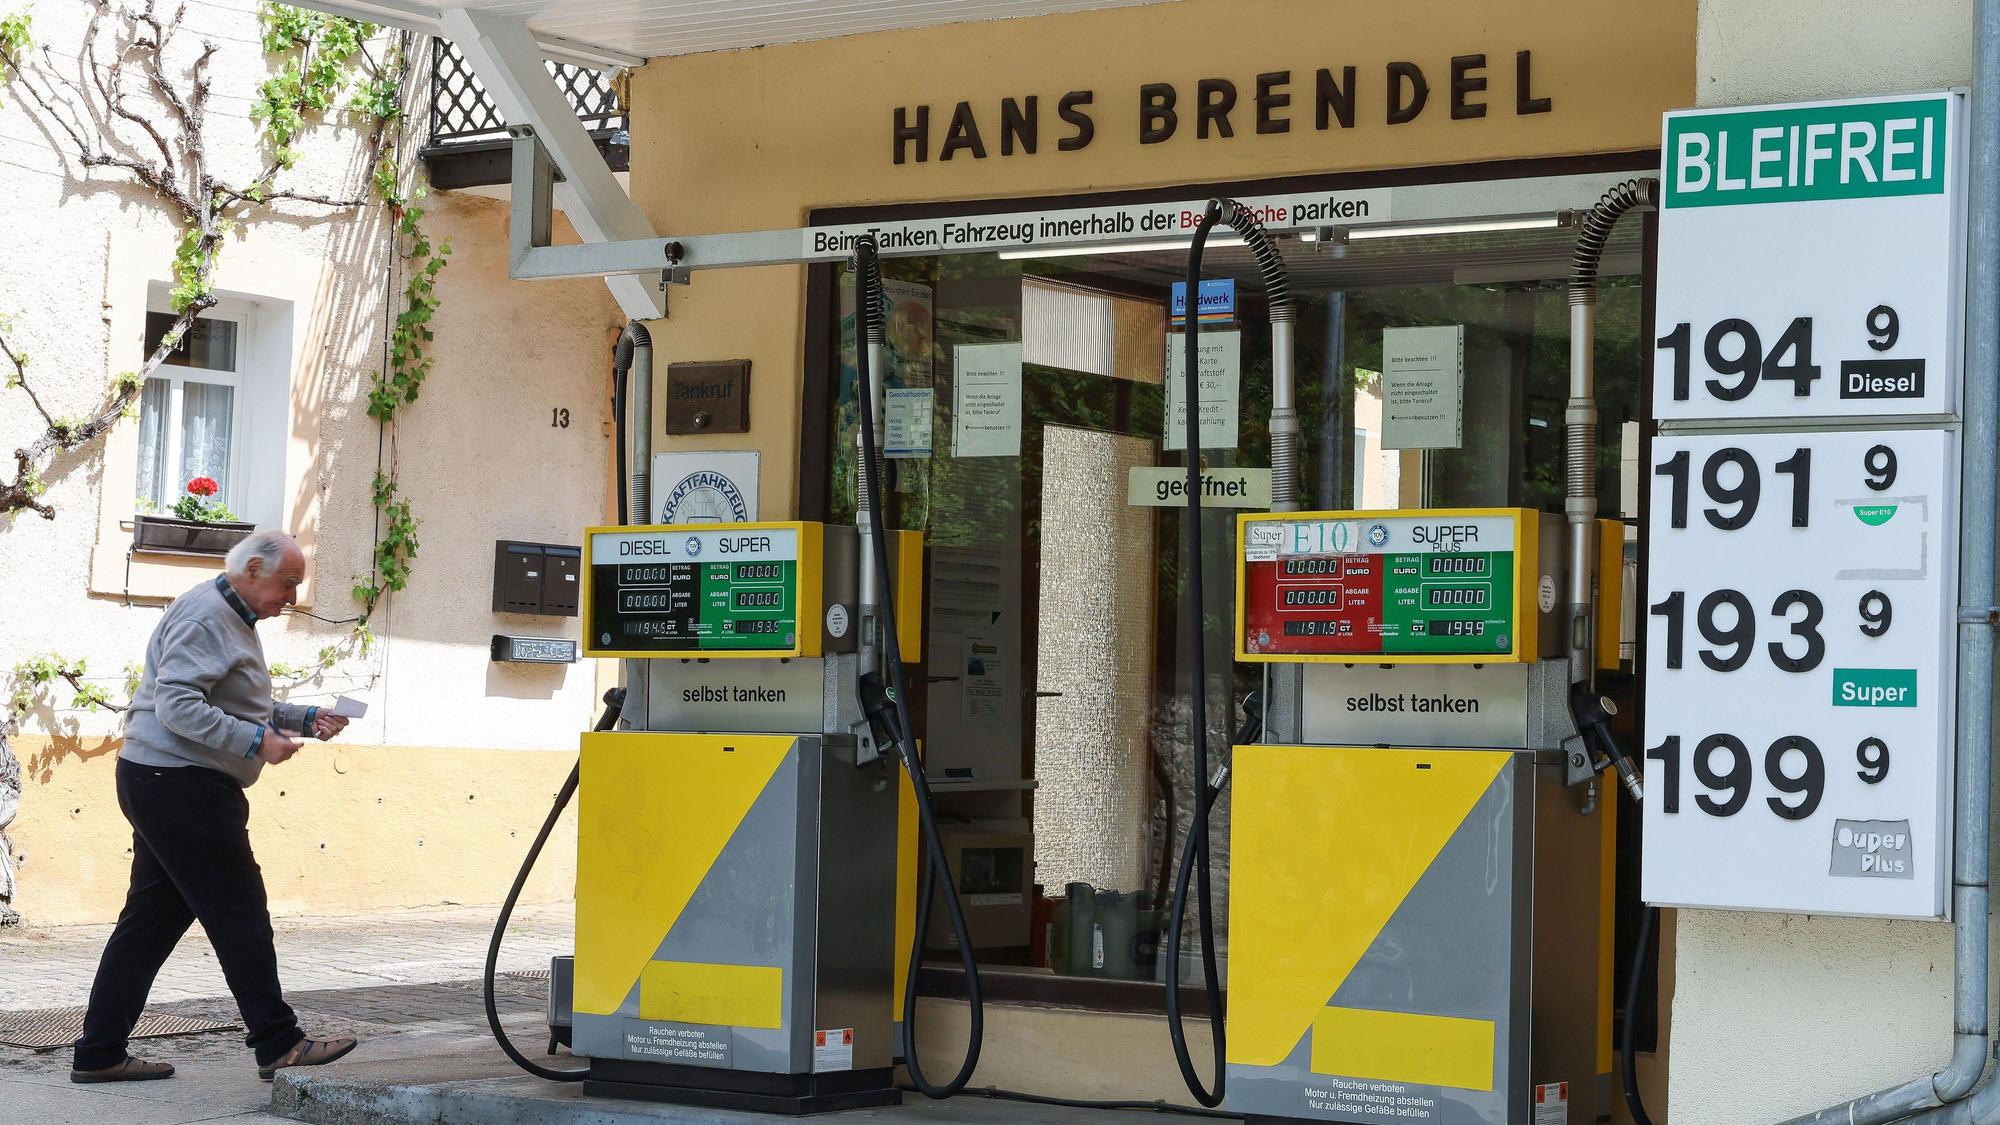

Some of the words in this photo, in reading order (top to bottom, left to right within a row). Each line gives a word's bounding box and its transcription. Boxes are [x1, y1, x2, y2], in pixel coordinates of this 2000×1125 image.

[893, 90, 1095, 165] HANS
[1139, 50, 1553, 145] BRENDEL
[1676, 116, 1934, 194] BLEIFREI
[814, 230, 859, 253] Beim
[867, 226, 937, 249] Tanken
[943, 222, 1034, 244] Fahrzeug
[1040, 212, 1134, 238] innerhalb
[1292, 197, 1369, 225] parken
[1176, 292, 1230, 307] Hdwerk
[1656, 317, 1822, 402] 194
[1866, 304, 1900, 352] 9
[673, 380, 733, 401] Tankruf
[1848, 372, 1916, 393] Diesel
[551, 407, 570, 429] 13
[1655, 447, 1812, 531] 191
[1863, 444, 1898, 491] 9
[1859, 509, 1879, 517] Super
[1879, 508, 1892, 516] E10
[1253, 527, 1282, 543] Super
[1294, 522, 1348, 554] E10
[1412, 525, 1479, 543] SUPER
[620, 540, 671, 556] DIESEL
[719, 536, 771, 553] SUPER
[1432, 541, 1461, 553] PLUS
[1650, 588, 1826, 673] 193
[1858, 589, 1893, 638] 9
[682, 685, 729, 702] selbst
[732, 685, 786, 702] tanken
[1346, 693, 1405, 712] selbst
[1410, 693, 1479, 713] tanken
[1841, 681, 1908, 706] Super
[1646, 732, 1826, 821] 199
[1856, 736, 1890, 785] 9
[1861, 854, 1905, 873] Plus
[627, 1034, 646, 1044] Motor
[646, 1037, 652, 1045] u.
[653, 1036, 697, 1049] Fremdheizung
[698, 1041, 727, 1051] abstellen
[649, 1026, 676, 1037] Rauchen
[677, 1029, 705, 1039] verboten
[631, 1044, 643, 1054] Nur
[643, 1046, 673, 1057] zulässige
[698, 1050, 724, 1060] befüllen
[1332, 1078, 1368, 1091] Rauchen
[1369, 1083, 1405, 1094] verboten
[1304, 1087, 1328, 1099] Motor
[1329, 1092, 1337, 1100] u.
[1337, 1091, 1395, 1106] Fremdheizung
[1396, 1096, 1434, 1107] abstellen
[1308, 1099, 1324, 1110] Nur
[1324, 1101, 1363, 1114] zulässige
[1396, 1106, 1430, 1118] befüllen
